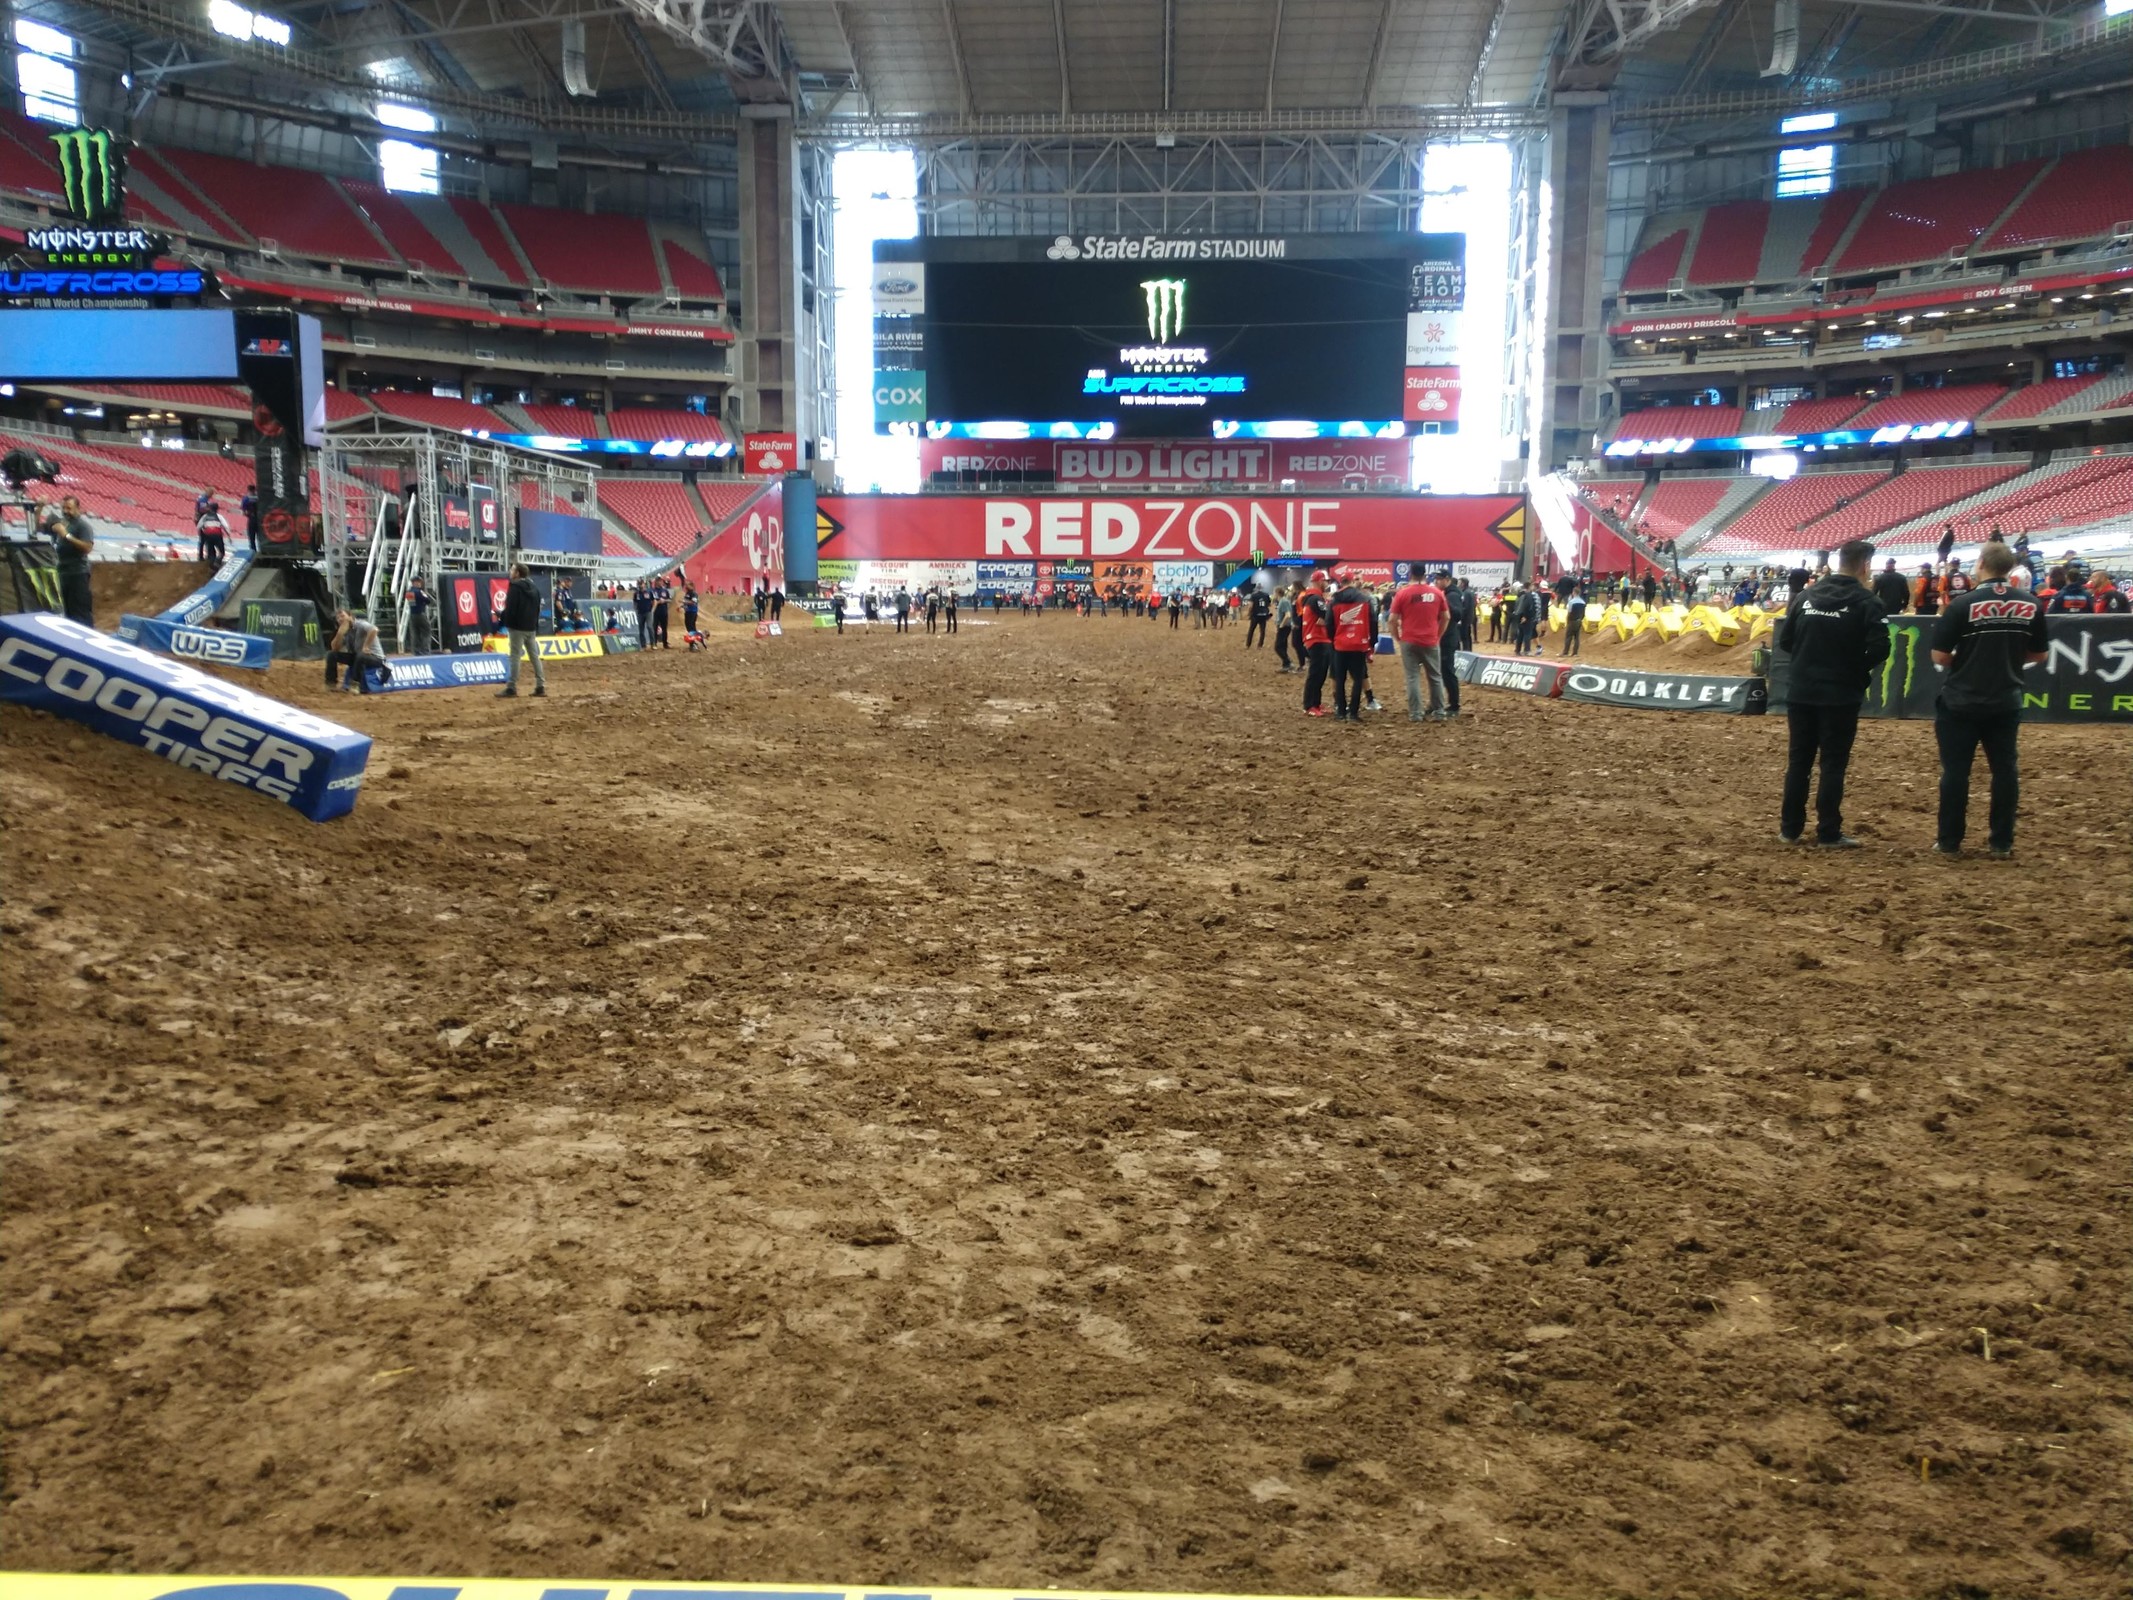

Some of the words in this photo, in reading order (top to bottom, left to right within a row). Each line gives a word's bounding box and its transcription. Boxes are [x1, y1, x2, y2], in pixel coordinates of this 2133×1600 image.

[28, 228, 148, 251] MONSTER
[1199, 239, 1286, 259] STADIUM
[48, 254, 132, 263] ENERGY
[1412, 275, 1462, 286] TEAM
[1412, 286, 1462, 297] SHOP
[1976, 288, 1997, 298] ROY
[1998, 284, 2033, 295] GREEN
[33, 298, 51, 308] FIM
[53, 298, 80, 308] World
[82, 298, 149, 309] Championship
[345, 296, 378, 307] ADRIAN
[378, 301, 412, 312] WILSON
[627, 326, 653, 335] JIMMY
[654, 328, 704, 338] CONZELMAN
[1631, 324, 1654, 333] JOHN
[1655, 322, 1692, 331] (PADDY)
[1693, 319, 1737, 328] DRISCOLL
[895, 333, 923, 341] RIVER
[1120, 346, 1208, 365] MONSTER
[1408, 345, 1434, 354] Dignity
[1435, 345, 1459, 353] Health
[1082, 376, 1245, 393] SUPERCROSS
[875, 387, 923, 405] COX
[1060, 449, 1142, 479] BUD
[1148, 449, 1265, 478] LIGHT
[978, 563, 1034, 572] COOPER
[1157, 564, 1209, 577] cbdMD
[1468, 566, 1510, 576] Husqvarna
[978, 580, 1034, 589] COOPER
[1056, 584, 1092, 592] TOOTA
[1421, 593, 1435, 603] 10
[1968, 599, 2037, 623] KYB
[260, 612, 293, 627] MONSTER
[170, 629, 248, 665] WPS
[457, 633, 482, 647] TOYOTA
[462, 660, 506, 675] YAMAHA
[459, 674, 505, 682] RACING
[1609, 678, 1740, 702] OAKLEY
[0, 637, 314, 784] COOPER
